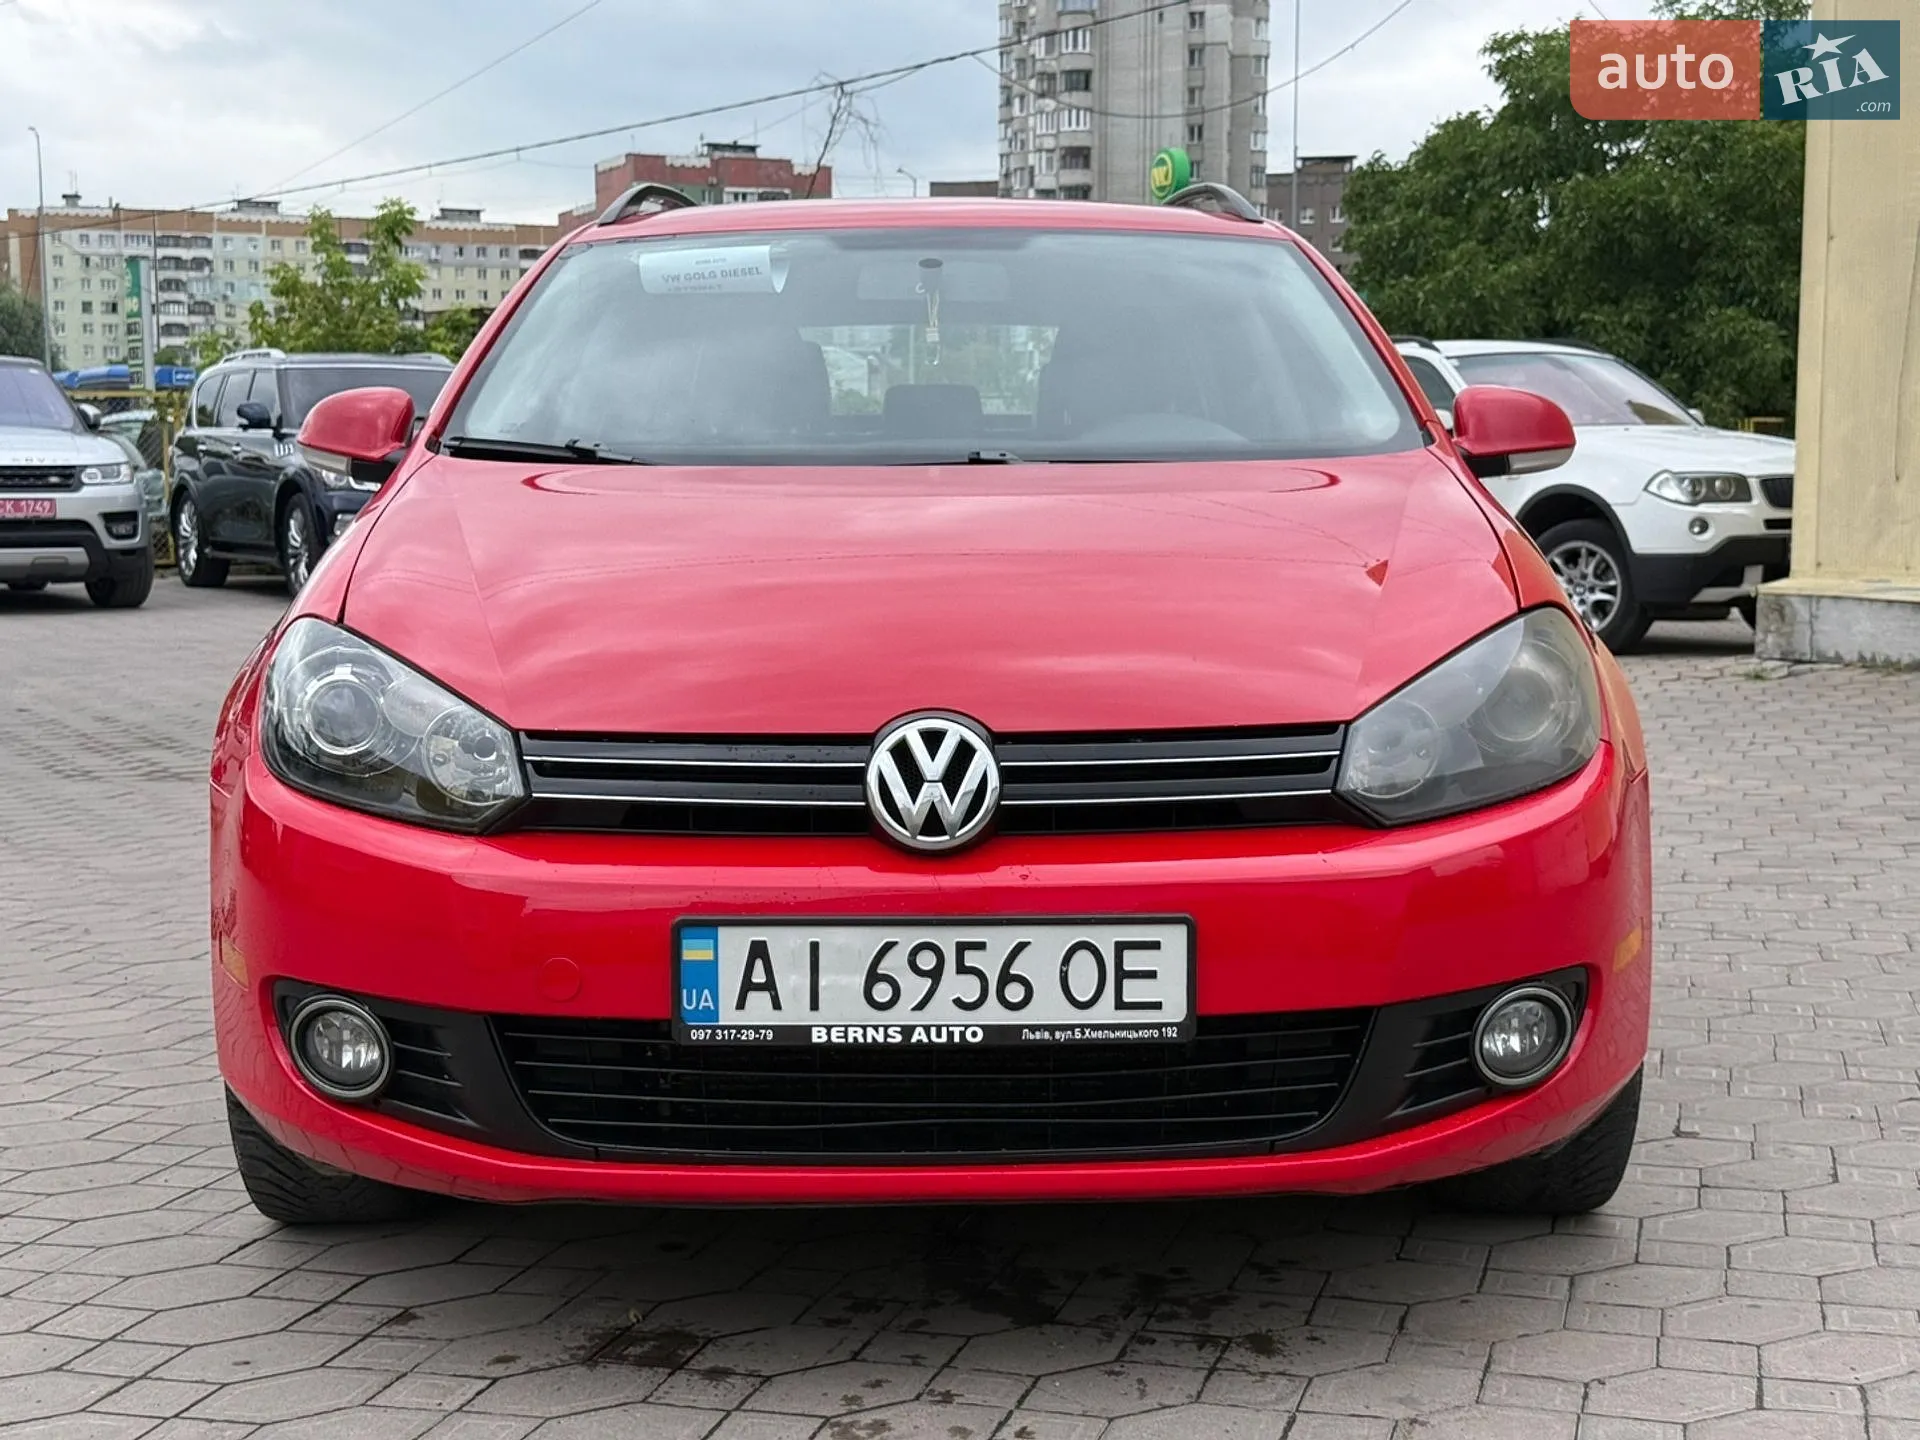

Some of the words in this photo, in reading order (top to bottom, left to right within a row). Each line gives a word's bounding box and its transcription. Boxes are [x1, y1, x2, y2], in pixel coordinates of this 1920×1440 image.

[720, 266, 763, 279] DIESEL
[735, 939, 820, 1011] AI
[863, 939, 1034, 1011] 6956
[1060, 939, 1162, 1011] OE
[681, 988, 715, 1011] UA
[690, 1029, 712, 1041] 097
[715, 1029, 774, 1041] 317-29-79
[811, 1026, 903, 1044] BERNS
[910, 1026, 984, 1044] AUTO
[1021, 1029, 1053, 1041] Львів,
[1161, 1026, 1178, 1038] 192
